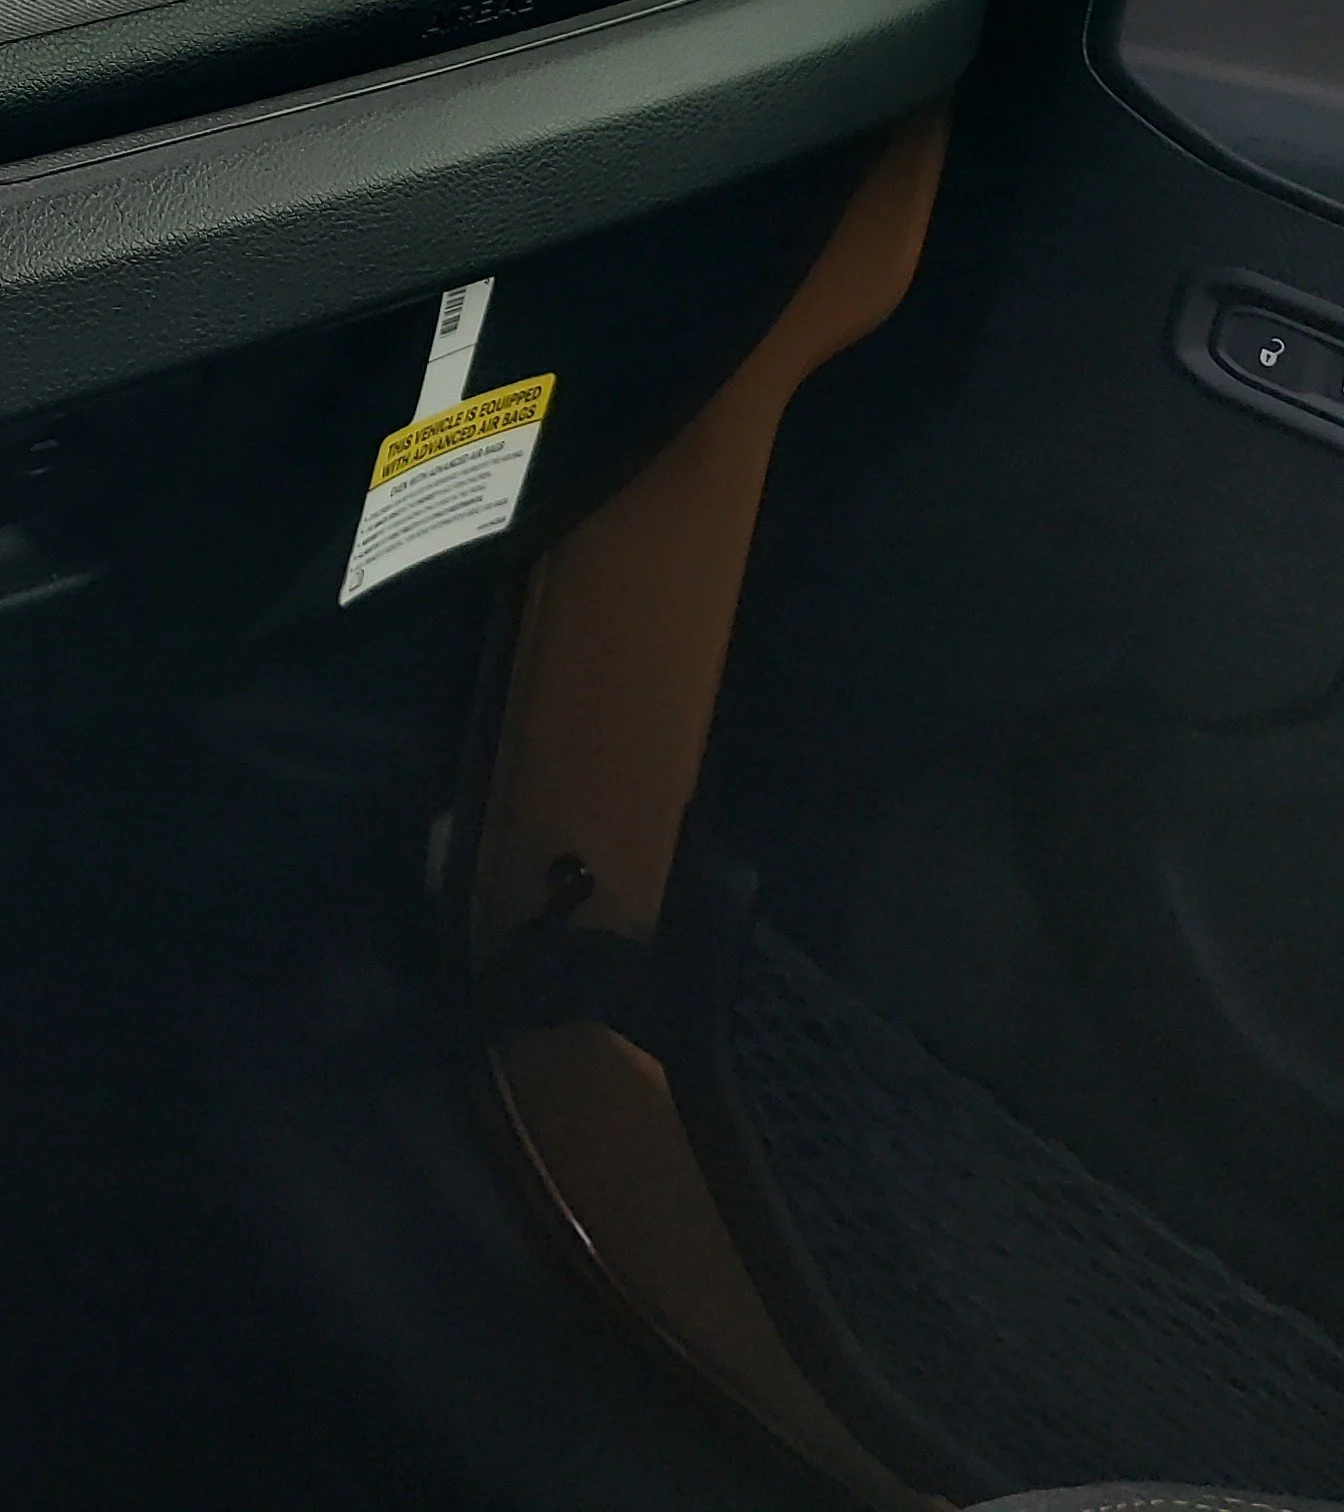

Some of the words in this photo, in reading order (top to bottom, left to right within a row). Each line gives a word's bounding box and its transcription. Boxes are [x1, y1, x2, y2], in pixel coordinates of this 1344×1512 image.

[381, 456, 409, 478] WITH
[413, 424, 476, 461] ADVANCED
[478, 416, 498, 435] AIR
[502, 404, 537, 425] BAGS
[387, 434, 412, 457] THIS
[415, 411, 463, 442] VEHICLE
[463, 405, 478, 422] IS
[479, 386, 542, 417] EQUIPPED
